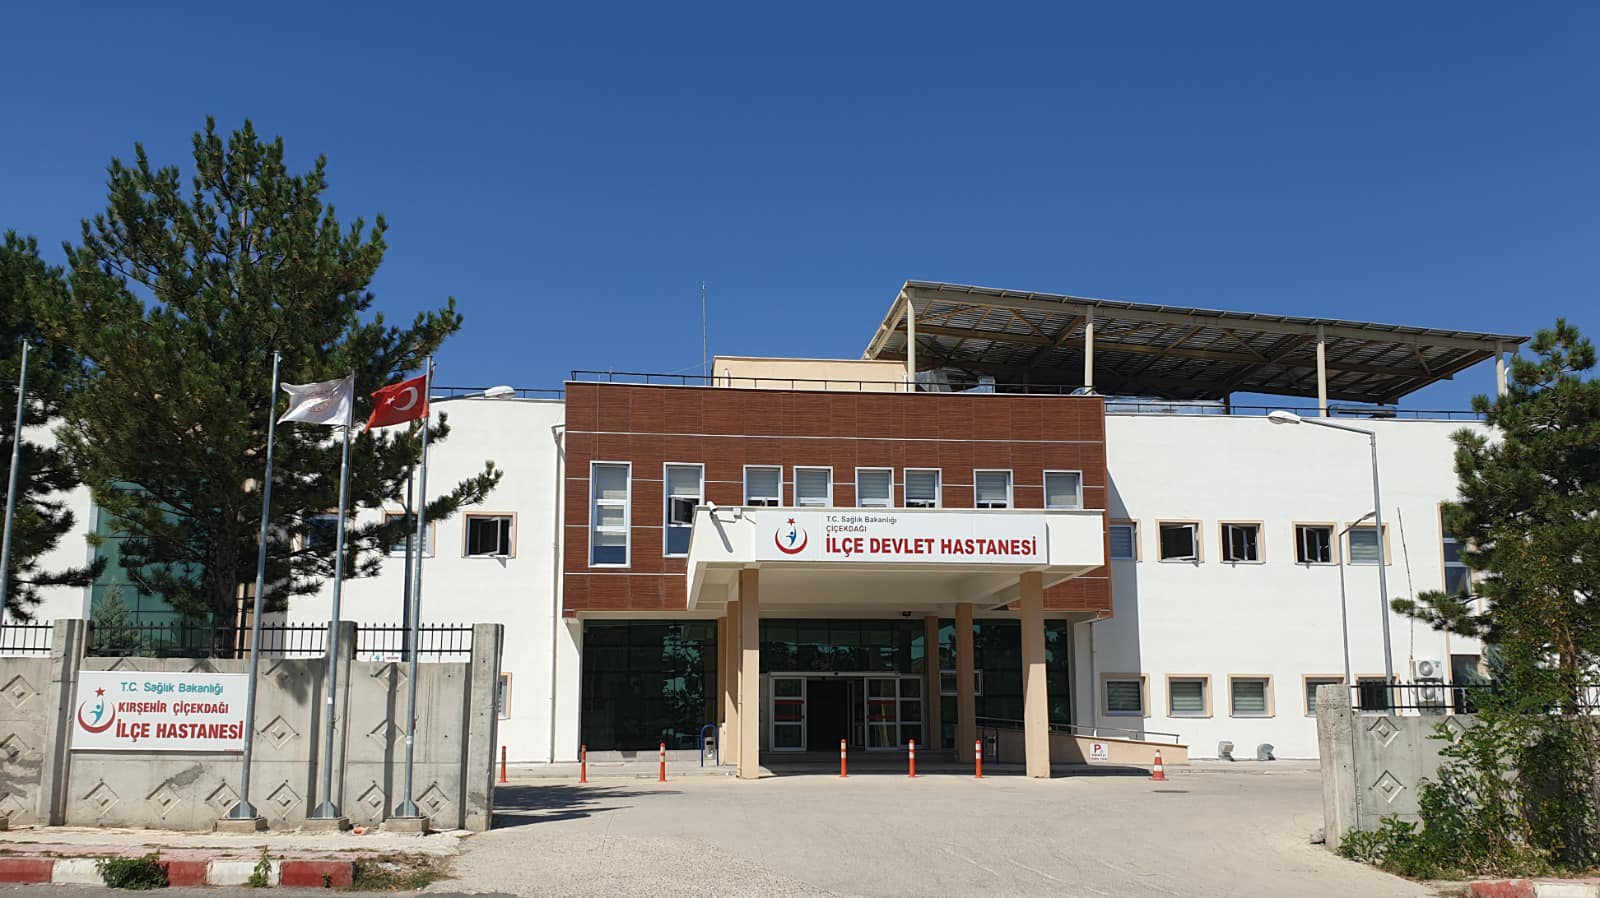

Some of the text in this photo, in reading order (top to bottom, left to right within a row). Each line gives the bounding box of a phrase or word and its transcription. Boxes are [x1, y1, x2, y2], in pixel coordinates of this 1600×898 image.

[841, 516, 863, 524] Sağlık
[864, 516, 897, 525] Bakanlığı
[826, 524, 867, 533] ÇİÇEKDAĞI
[826, 534, 1037, 557] İLÇE DEVLET HASTANESİ
[143, 682, 174, 694] Sağlık
[178, 683, 224, 695] Bakanlığı
[118, 700, 229, 716] KIRŞEHİR ÇİÇEKDAĞI
[116, 718, 244, 742] İLÇE HASTANESİ
[1094, 744, 1101, 753] P
